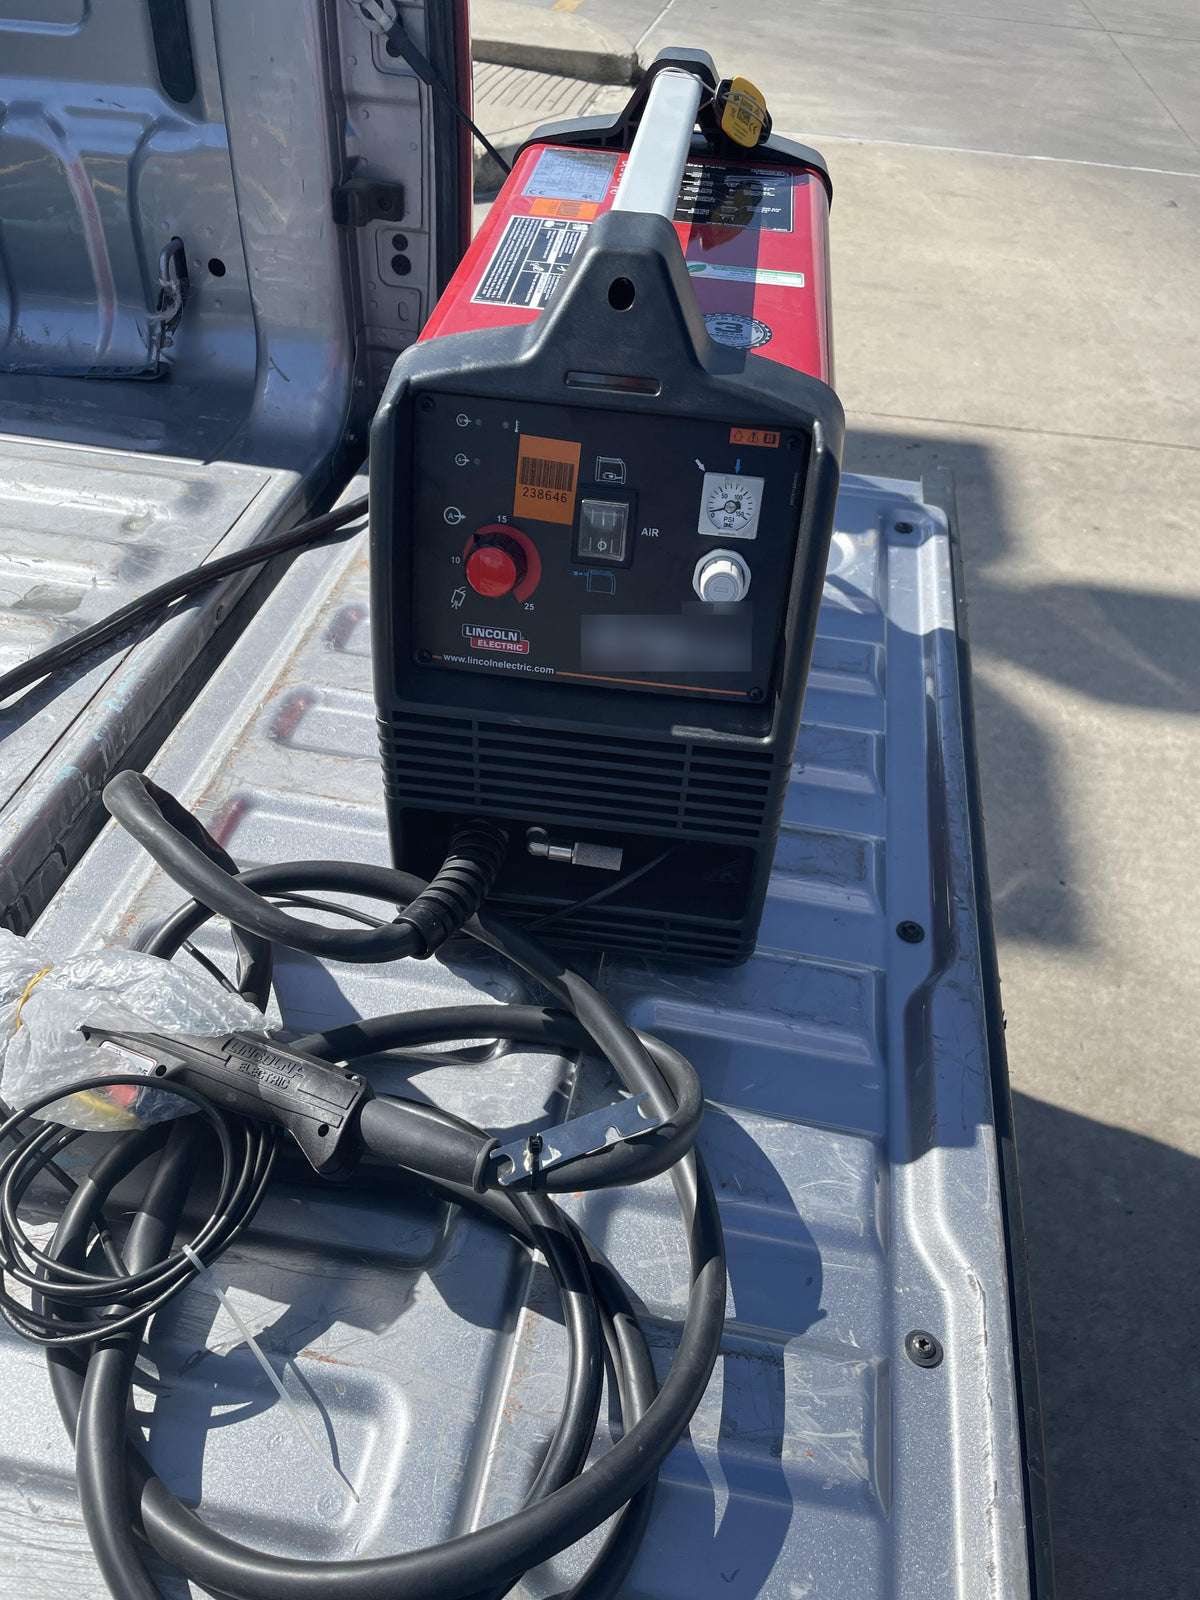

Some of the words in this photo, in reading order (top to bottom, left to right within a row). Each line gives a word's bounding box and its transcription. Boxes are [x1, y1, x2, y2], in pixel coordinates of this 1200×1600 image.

[714, 321, 743, 333] 3
[522, 486, 568, 503] 238646
[721, 492, 728, 500] 50
[497, 515, 508, 523] 15
[640, 527, 660, 537] AIR
[451, 556, 461, 564] 10
[524, 602, 535, 611] 25
[465, 626, 518, 642] LINCOLN
[477, 639, 524, 652] ELECTRIC
[443, 653, 555, 675] www.lincolnelectric.com
[229, 1041, 296, 1077] LINCOLN
[237, 1062, 291, 1090] ELECTRIC
